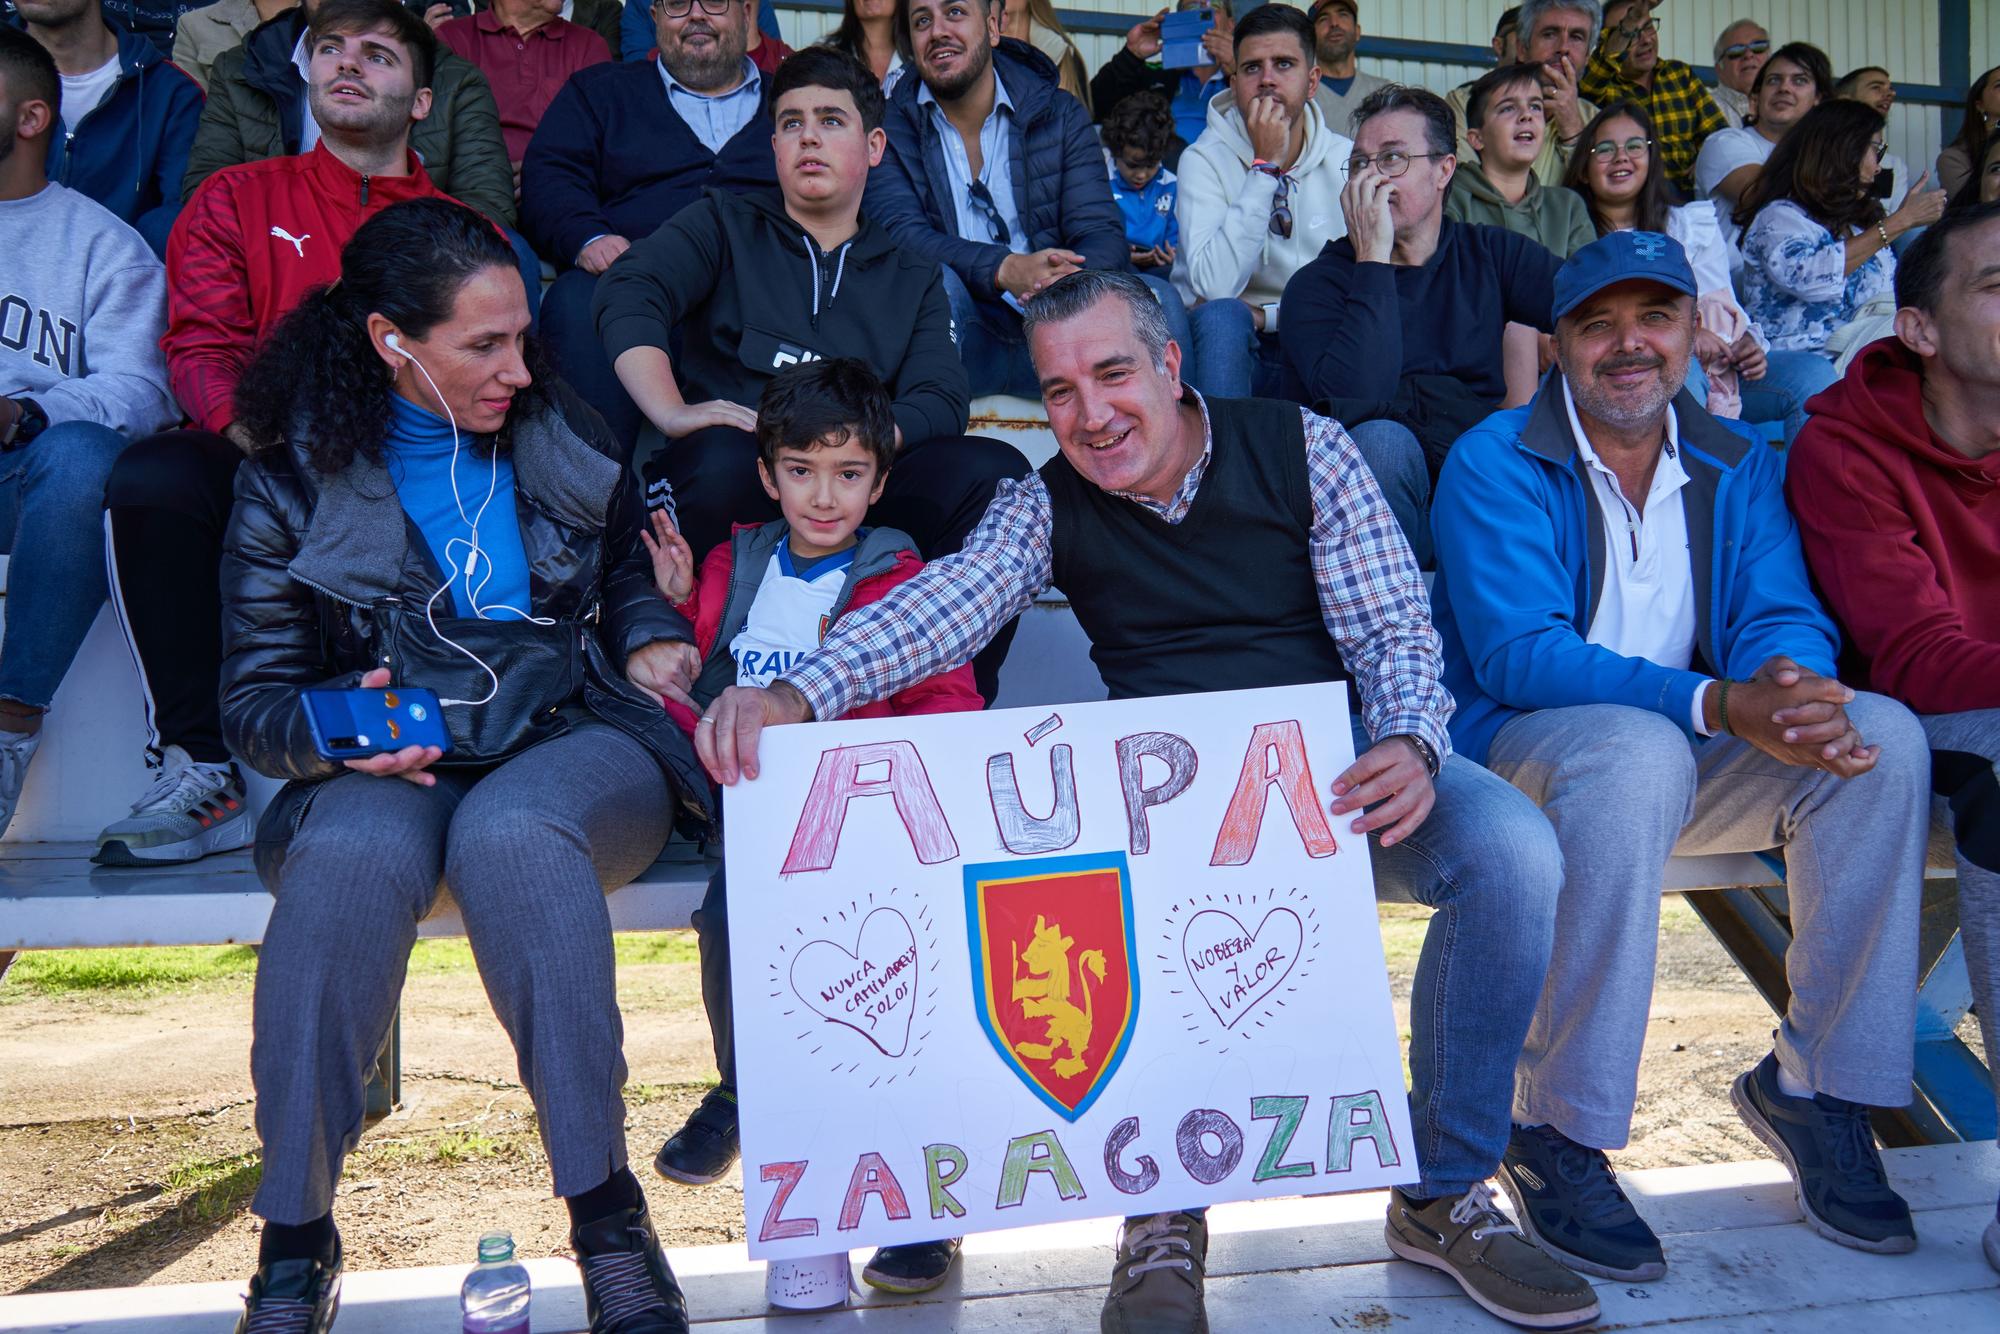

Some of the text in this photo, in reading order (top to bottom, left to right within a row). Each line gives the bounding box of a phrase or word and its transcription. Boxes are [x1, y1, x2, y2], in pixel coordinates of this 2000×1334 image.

[780, 713, 1338, 877] AÚPA
[820, 960, 876, 1002] NUNCA
[864, 981, 909, 1030] SOLOS
[1219, 947, 1286, 1009] VALOR
[759, 1090, 1401, 1243] ZARAGOZA
